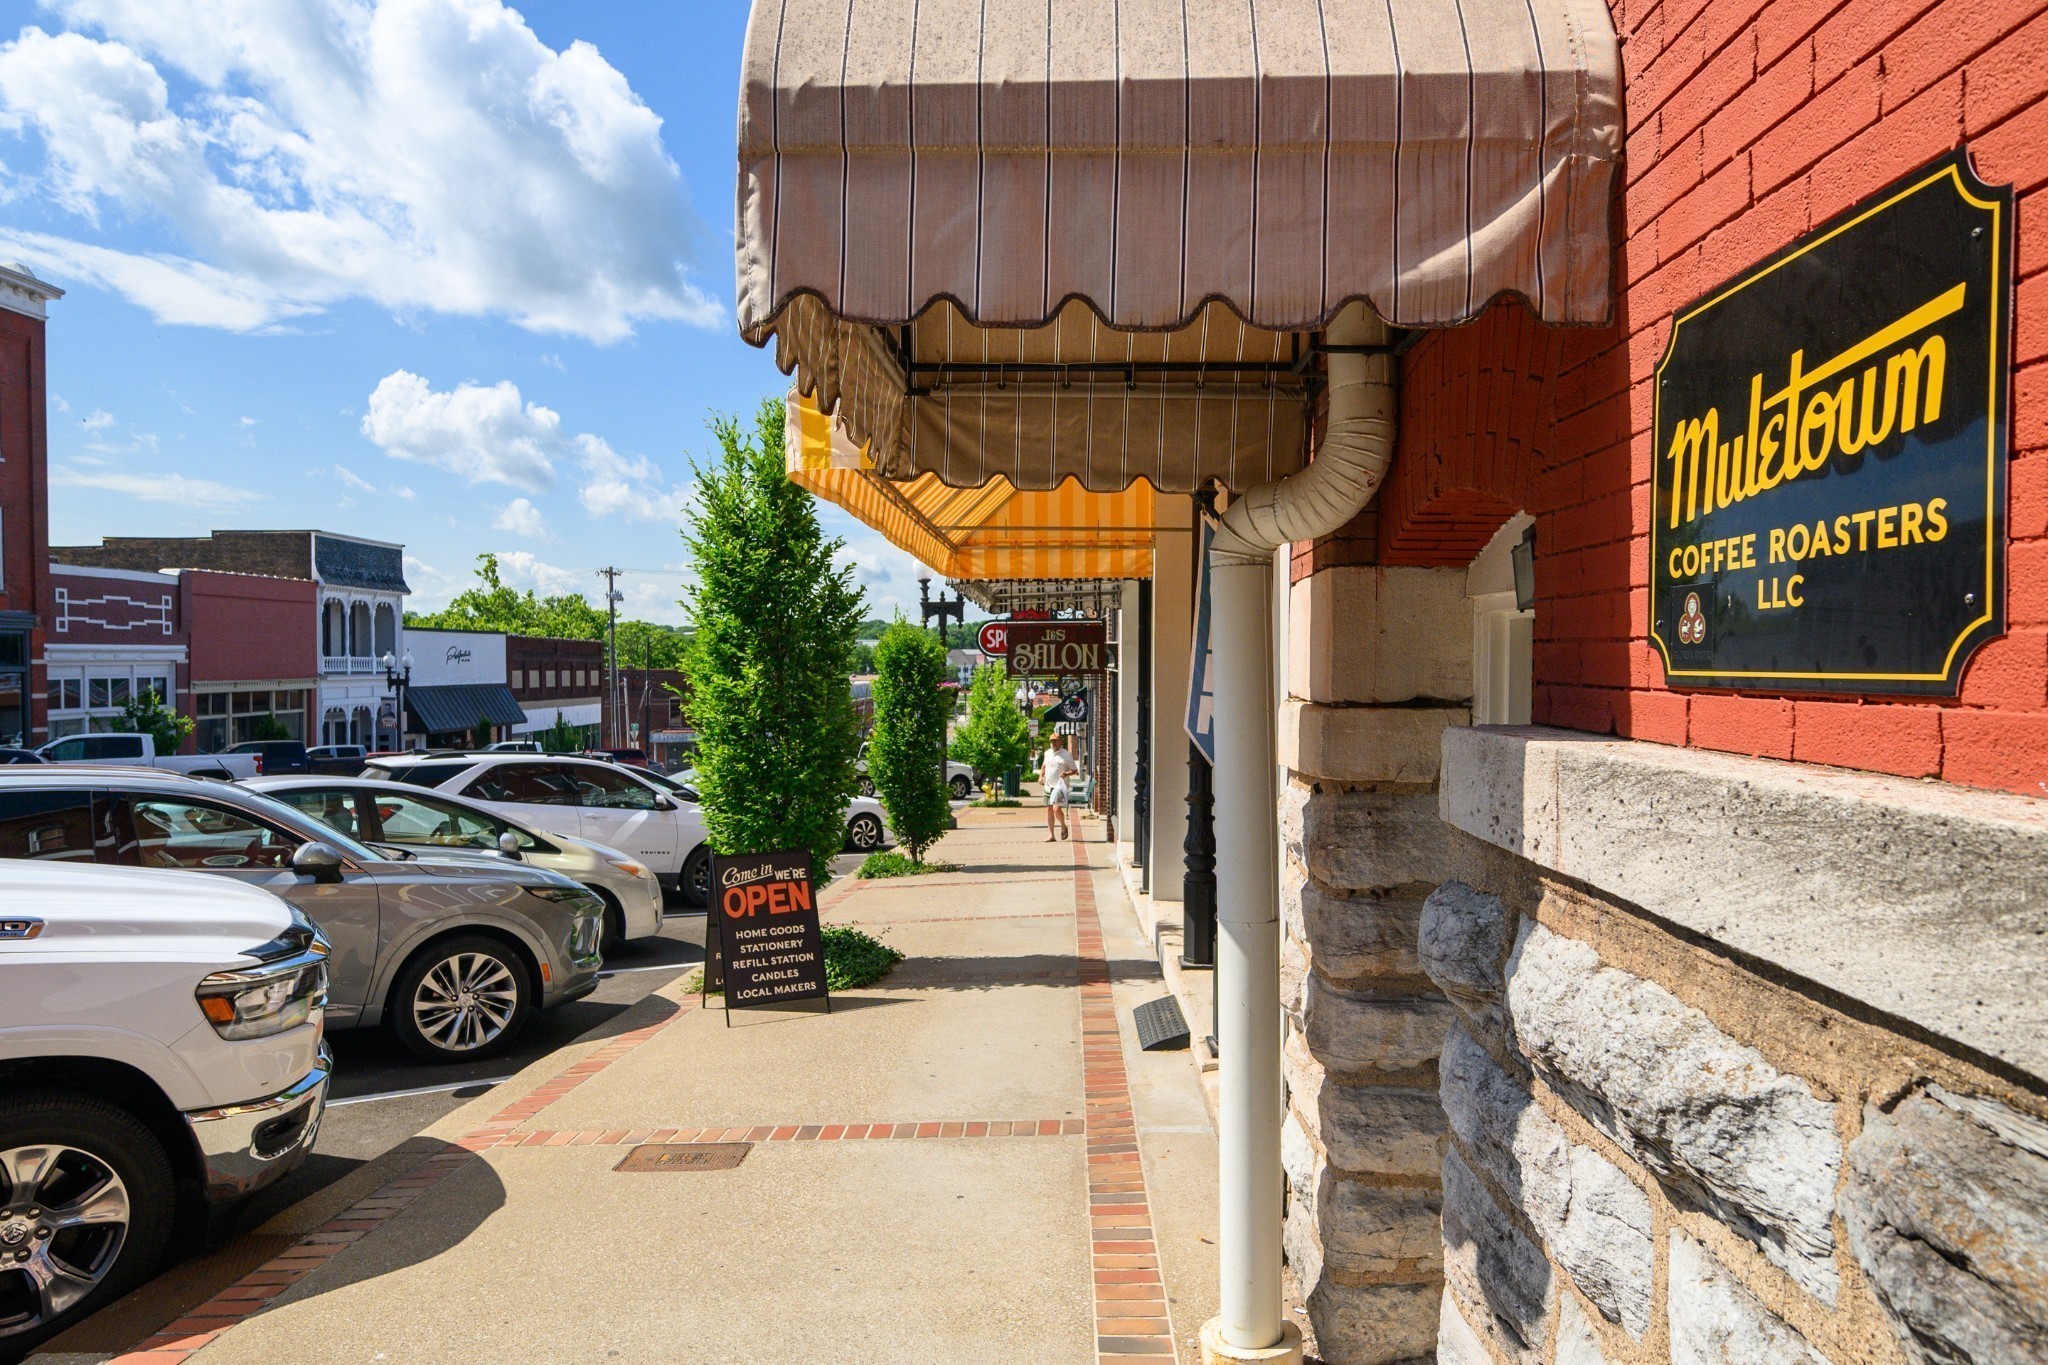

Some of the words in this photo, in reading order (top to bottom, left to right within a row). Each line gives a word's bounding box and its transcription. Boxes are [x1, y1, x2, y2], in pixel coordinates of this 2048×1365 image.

[1667, 282, 1966, 529] Muletown
[1669, 534, 1756, 579] COFFEE
[1769, 498, 1947, 564] ROASTERS
[1757, 575, 1805, 610] LLC
[1041, 629, 1066, 641] J&S
[1013, 643, 1100, 674] SALON
[722, 867, 757, 886] Come
[760, 864, 774, 876] in
[774, 867, 807, 881] WE'RE
[723, 881, 811, 919] OPEN
[736, 928, 768, 939] HOME
[769, 925, 805, 936] GOODS
[740, 939, 804, 954] STATIONERY
[733, 958, 769, 969] REFILL
[771, 953, 814, 965] STATION
[752, 969, 799, 982] CANDLES
[737, 988, 772, 999] LOCAL
[774, 982, 816, 994] MAKERS
